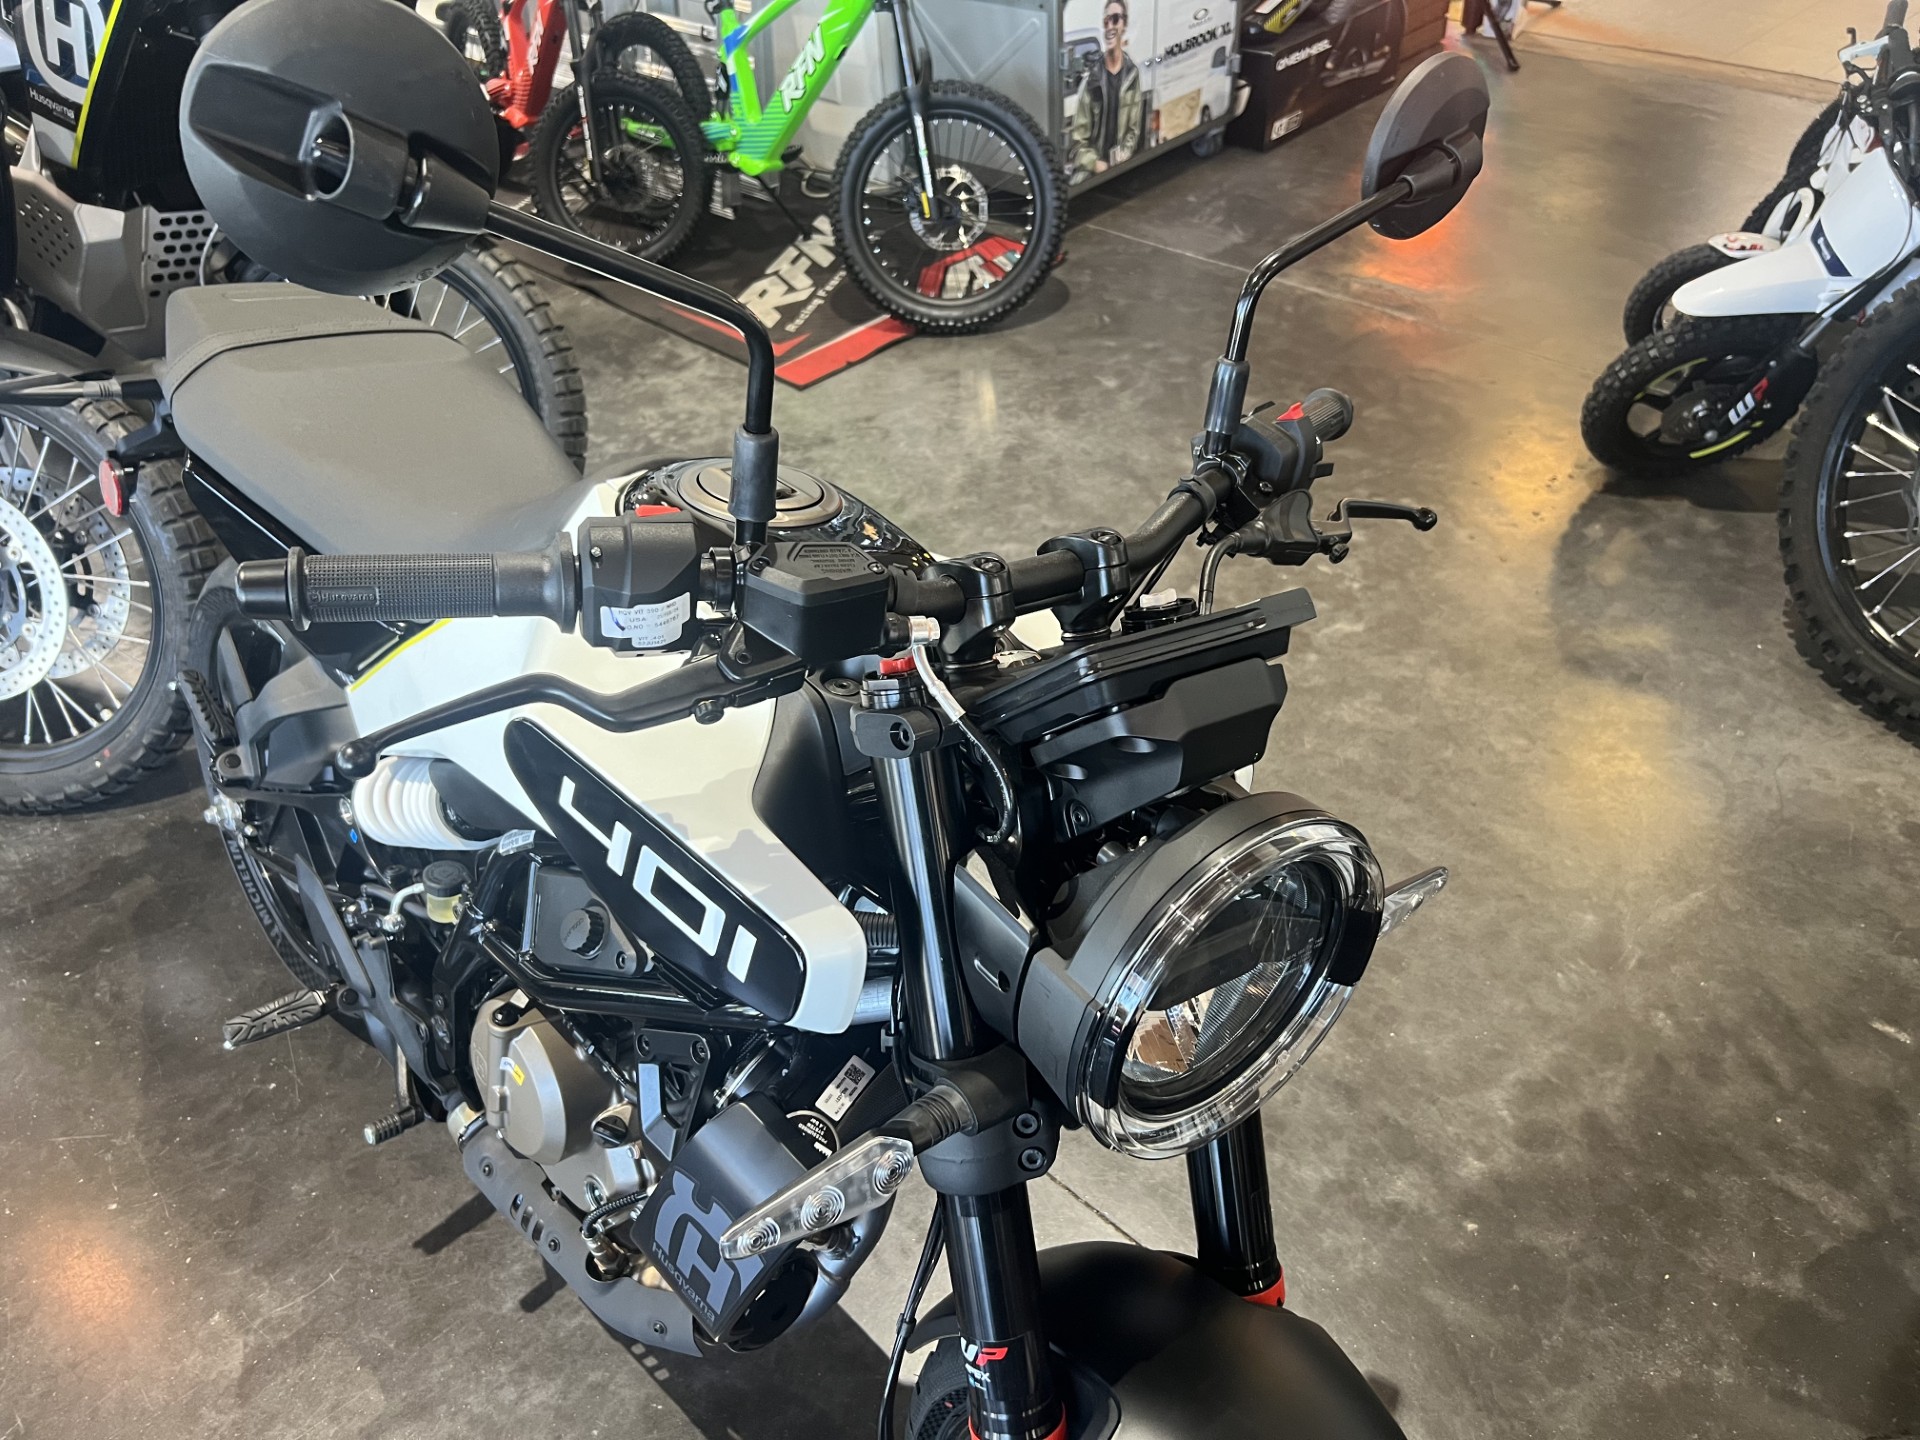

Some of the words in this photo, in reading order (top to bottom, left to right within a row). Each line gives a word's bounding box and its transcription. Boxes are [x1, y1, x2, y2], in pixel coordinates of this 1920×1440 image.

[29, 87, 75, 119] Husqvarna
[228, 840, 272, 925] MICHELIN
[651, 1241, 715, 1322] Husqvarna
